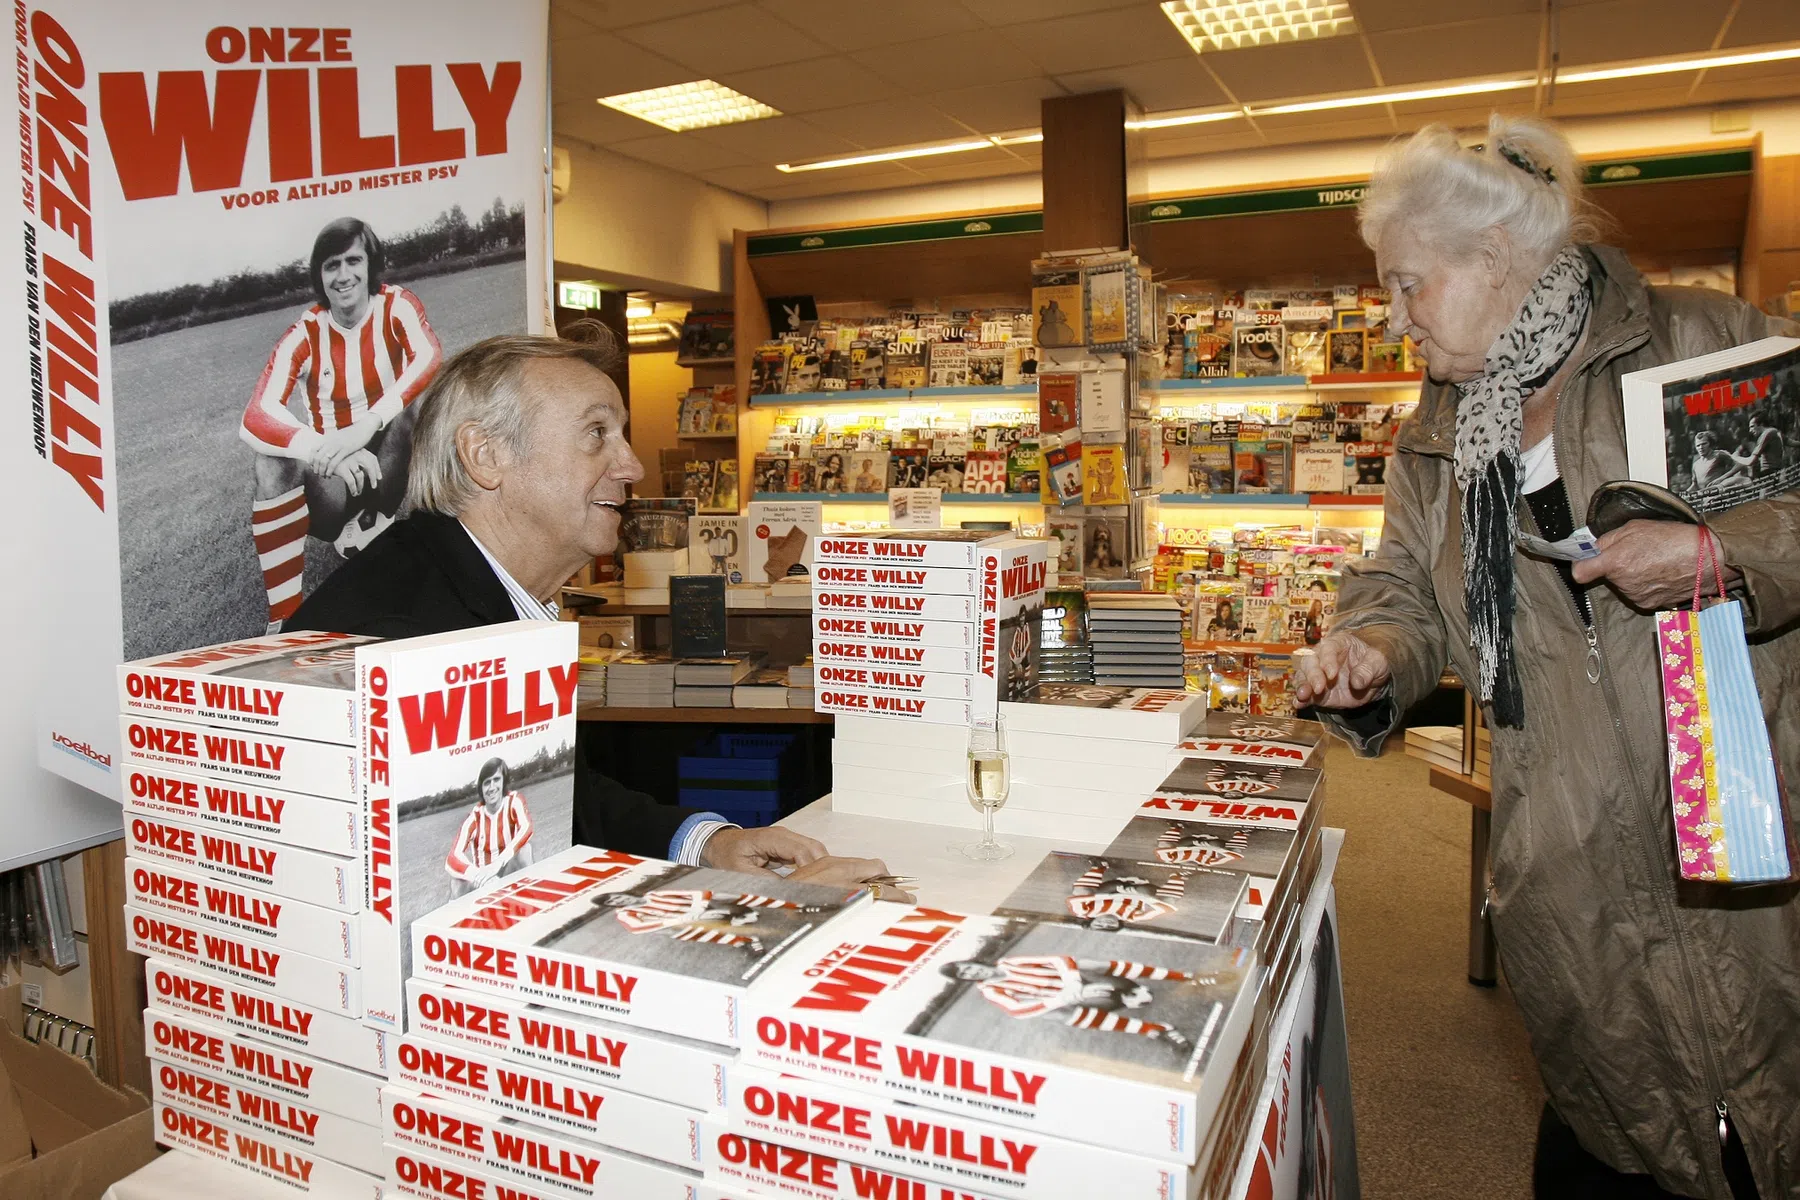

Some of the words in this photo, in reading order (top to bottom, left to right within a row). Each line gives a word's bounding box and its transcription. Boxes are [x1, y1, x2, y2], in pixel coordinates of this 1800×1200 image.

[15, 0, 27, 47] VOOR
[205, 26, 352, 62] ONZE
[16, 46, 30, 110] ALTIJD
[19, 109, 33, 177] MISTER
[31, 10, 94, 262] ONZE
[98, 61, 521, 201] WILLY
[22, 175, 35, 215] PSV
[221, 187, 280, 210] VOOR
[287, 179, 353, 203] ALTIJD
[358, 170, 423, 190] MISTER
[428, 164, 459, 182] PSV
[24, 219, 38, 279] FRANS
[26, 279, 39, 315] VAN
[28, 313, 41, 350] DEN
[887, 341, 925, 356] SINT
[933, 349, 967, 358] ELSEVIER
[1240, 331, 1278, 344] roots
[42, 252, 105, 514] WILLY
[904, 369, 923, 377] SINT
[1199, 366, 1228, 377] Allah
[30, 350, 47, 460] NIEUWENHOF
[1683, 373, 1773, 416] WILLY
[965, 460, 1007, 480] APP
[1017, 458, 1036, 466] Boek
[1345, 443, 1375, 455] Quest
[821, 541, 868, 554] ONZE
[874, 544, 926, 556] WILLY
[1013, 555, 1028, 566] ONZE
[819, 568, 866, 582] ONZE
[873, 570, 926, 584] WILLY
[983, 556, 998, 613] ONZE
[1001, 561, 1047, 598] WILLY
[819, 594, 866, 608] ONZE
[872, 596, 924, 610] WILLY
[820, 618, 865, 633] ONZE
[872, 622, 923, 636] WILLY
[981, 618, 996, 679] WILLY
[444, 657, 506, 685] ONZE
[820, 643, 866, 658] ONZE
[872, 646, 924, 661] WILLY
[127, 673, 196, 705] ONZE
[202, 682, 283, 716] WILLY
[821, 668, 867, 683] ONZE
[873, 672, 924, 687] WILLY
[398, 661, 579, 755] WILLY
[822, 692, 868, 708] ONZE
[874, 697, 924, 712] WILLY
[52, 731, 111, 767] voetbal
[129, 724, 199, 757] ONZE
[205, 736, 284, 770] WILLY
[369, 666, 390, 788] ONZE
[449, 744, 473, 757] VOOR
[475, 735, 504, 752] ALTIJD
[506, 728, 534, 745] MISTER
[536, 722, 550, 735] PSV
[1177, 741, 1304, 760] WILLY
[131, 773, 199, 808] ONZE
[205, 786, 284, 823] WILLY
[1141, 798, 1298, 821] WILLY
[133, 820, 197, 856] ONZE
[202, 836, 277, 875] WILLY
[371, 798, 392, 925] WILLY
[134, 869, 199, 907] ONZE
[205, 887, 281, 927] WILLY
[449, 849, 647, 931] WILLY
[474, 877, 538, 904] ONZE
[134, 916, 199, 954] ONZE
[204, 935, 280, 977] WILLY
[424, 935, 517, 978] ONZE
[528, 955, 638, 1003] WILLY
[791, 907, 968, 1013] WILLY
[803, 942, 860, 978] ONZE
[156, 971, 225, 1011] ONZE
[232, 992, 312, 1035] WILLY
[424, 965, 442, 973] VOOR
[445, 970, 468, 980] ALTIJD
[472, 975, 498, 986] MISTER
[500, 982, 514, 990] PSV
[520, 986, 542, 996] FRANS
[545, 992, 559, 1000] VAN
[562, 996, 576, 1004] DEN
[419, 993, 510, 1039] ONZE
[520, 1017, 627, 1067] WILLY
[154, 1021, 225, 1062] ONZE
[231, 1044, 313, 1088] WILLY
[757, 1016, 882, 1070] ONZE
[896, 1046, 1046, 1104] WILLY
[160, 1066, 231, 1108] ONZE
[237, 1091, 319, 1136] WILLY
[399, 1044, 488, 1091] ONZE
[498, 1069, 603, 1121] WILLY
[163, 1108, 229, 1151] ONZE
[236, 1135, 312, 1181] WILLY
[394, 1103, 484, 1152] ONZE
[493, 1130, 600, 1184] WILLY
[744, 1086, 871, 1140] ONZE
[886, 1115, 1037, 1174] WILLY
[397, 1156, 486, 1200] ONZE
[718, 1134, 838, 1190] ONZE
